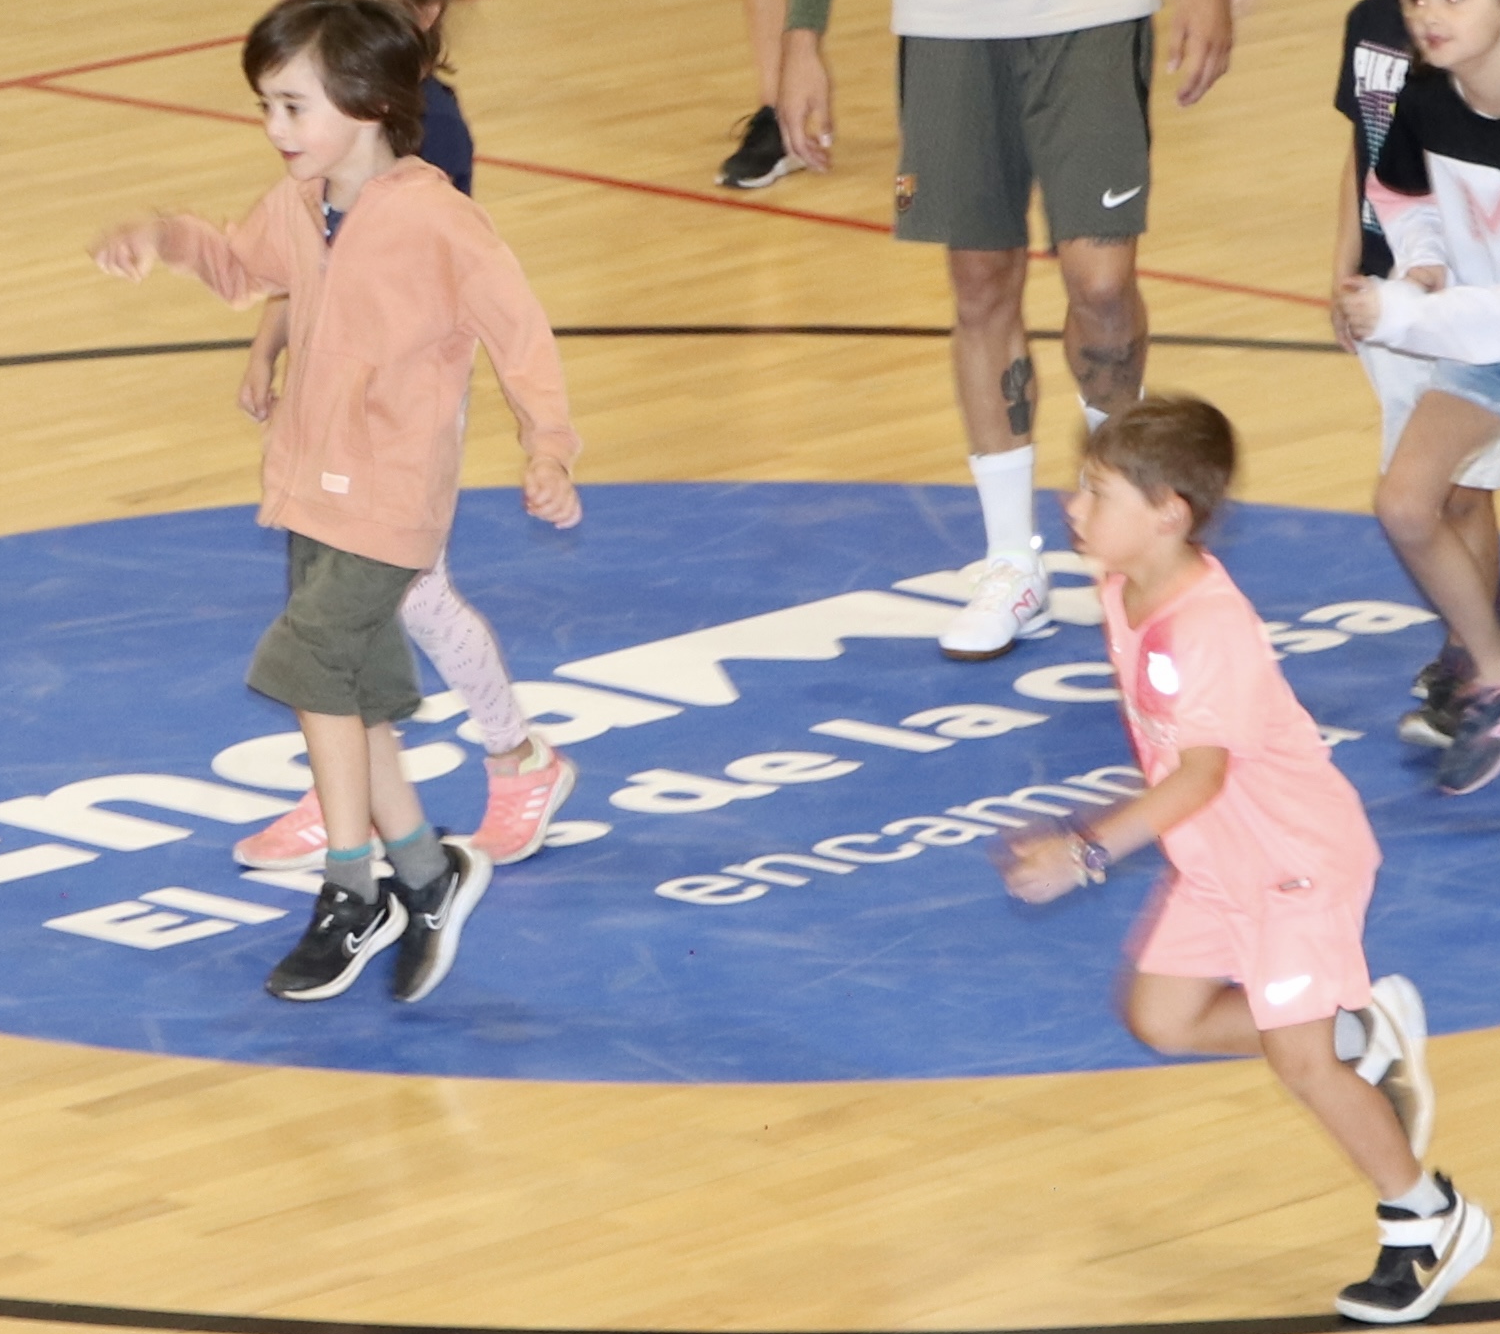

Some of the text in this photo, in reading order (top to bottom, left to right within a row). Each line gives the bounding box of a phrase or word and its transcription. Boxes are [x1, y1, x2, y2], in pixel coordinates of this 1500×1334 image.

[42, 886, 290, 952] El
[608, 750, 864, 814] de
[808, 703, 1051, 754] la
[1013, 599, 1441, 703] csa
